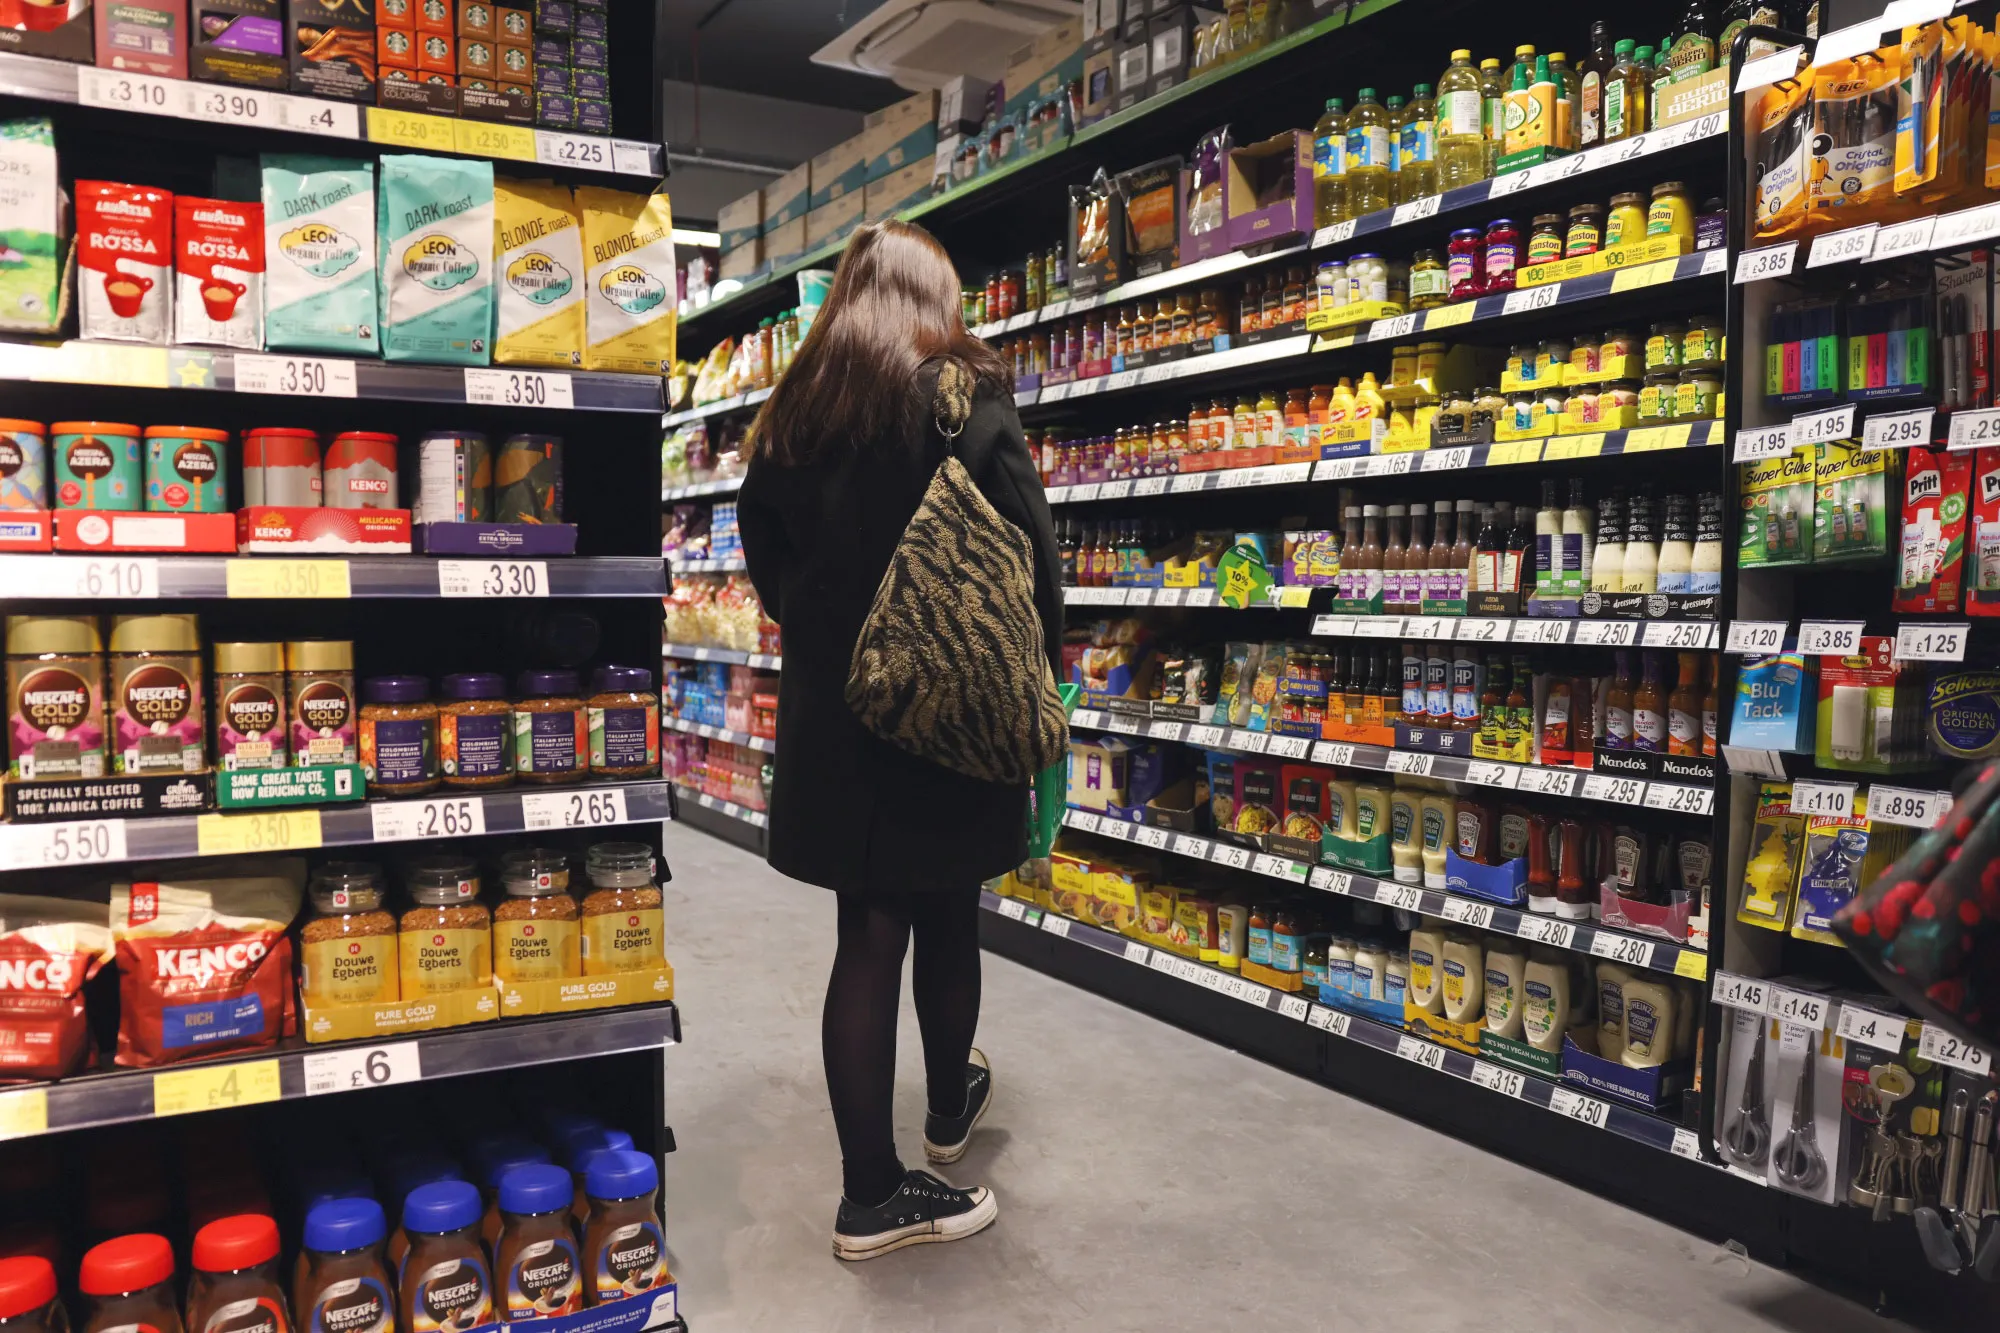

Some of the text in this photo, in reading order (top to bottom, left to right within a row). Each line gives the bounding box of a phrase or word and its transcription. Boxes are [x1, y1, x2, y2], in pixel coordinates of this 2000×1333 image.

[1672, 47, 1705, 63] FILIPPO
[383, 89, 428, 104] COLOMBIA
[1673, 79, 1726, 104] FILIPPO
[463, 94, 510, 108] HOUSE BLEND
[1682, 114, 1720, 143] £4.90
[558, 140, 603, 165] £2.25
[1620, 136, 1646, 160] £2
[1563, 154, 1586, 177] £2
[1835, 155, 1894, 173] Original
[1509, 170, 1531, 192] £2
[96, 199, 153, 218] LAVAZZA
[283, 183, 354, 218] DARK roast
[192, 209, 246, 226] LAVAZZA
[405, 194, 474, 231] DARK roast
[302, 229, 338, 244] LEON
[501, 215, 572, 250] BLONDE roast
[89, 233, 158, 255] ROSSA
[187, 241, 251, 261] ROSSA
[422, 240, 457, 255] LEON
[593, 226, 666, 263] BLONDE roast
[408, 258, 472, 275] Organic Coffee
[525, 259, 553, 273] LEON
[1752, 252, 1788, 275] £3.85
[511, 274, 569, 291] Organic Coffee
[617, 270, 646, 284] LEON
[1937, 264, 1987, 296] Sharpie
[605, 284, 661, 301] Organic Coffee
[505, 374, 546, 405] £3.50
[1808, 415, 1845, 439] £1.95
[1881, 419, 1922, 443] £2.95
[1752, 432, 1787, 453] £1.95
[69, 455, 111, 468] AZERA
[177, 459, 215, 471] AZERA
[1850, 451, 1881, 468] Glue
[1744, 461, 1812, 486] Super Glue
[350, 480, 388, 492] KENCO
[1911, 474, 1938, 495] Pritt
[359, 516, 404, 526] MILLICANO
[254, 527, 293, 539] KENCO
[483, 564, 537, 596] £3.30
[1231, 570, 1249, 587] 10%
[1479, 604, 1505, 612] VINEGAR
[1613, 596, 1643, 609] dressings
[1681, 597, 1714, 610] dressings
[1424, 620, 1441, 638] £1
[1476, 620, 1497, 641] £2
[1532, 622, 1563, 642] £1.40
[1596, 623, 1630, 645] £2.50
[1666, 625, 1701, 647] £2.50
[1744, 629, 1777, 647] £1.20
[1816, 630, 1853, 649] £3.85
[1916, 634, 1957, 654] £1.25
[1404, 667, 1420, 681] HP
[1428, 667, 1445, 682] HP
[1454, 669, 1472, 684] HP
[1751, 683, 1780, 699] Blu
[31, 705, 82, 718] GOLD
[136, 699, 183, 714] GOLD
[308, 709, 345, 721] GOLD
[1743, 702, 1784, 719] Tack
[1942, 709, 1996, 721] ORIGINAL
[37, 717, 75, 725] BLEND
[142, 712, 178, 720] BLEND
[235, 712, 272, 724] GOLD
[1942, 718, 1995, 730] GOLDEN
[1410, 731, 1423, 741] HP
[1440, 735, 1453, 746] HP
[1600, 754, 1648, 770] Nando's
[1662, 760, 1714, 778] Nando's
[231, 773, 291, 787] SAME GREAT
[1484, 765, 1506, 786] £2
[17, 783, 141, 801] SPECIALLY SELECTED
[231, 784, 306, 800] NOW REDUCING
[1604, 780, 1637, 803] £2.95
[16, 797, 144, 815] 100% ARABICA COFFEE
[1667, 788, 1706, 813] £2.95
[1809, 791, 1845, 811] £1.10
[1885, 796, 1926, 820] £8.95
[565, 792, 617, 827] £2.65
[1359, 810, 1374, 818] SALAD
[417, 801, 473, 838] £2.65
[1229, 848, 1244, 866] 75p
[1267, 858, 1287, 879] 75p
[132, 895, 155, 912] 93
[616, 927, 650, 939] Douwe
[1537, 922, 1568, 946] £2.80
[511, 936, 548, 948] Douwe
[614, 936, 652, 951] Egberts
[155, 941, 268, 978] KENCO
[334, 954, 374, 967] Douwe
[420, 946, 459, 959] Douwe
[509, 946, 551, 960] Egberts
[1612, 939, 1647, 965] £2.80
[418, 956, 462, 971] Egberts
[332, 965, 377, 981] Egberts
[560, 981, 617, 995] PURE GOLD
[1729, 983, 1762, 1005] £1.45
[376, 1005, 436, 1020] PURE GOLD
[1527, 1000, 1548, 1009] VEGAN
[1631, 1001, 1653, 1014] HEINZ
[1784, 998, 1820, 1022] £1.45
[185, 1012, 214, 1028] RICH
[1860, 1020, 1876, 1039] £4
[1511, 1045, 1530, 1058] VEGAN
[1531, 1053, 1549, 1065] MAYO
[1940, 1038, 1982, 1066] £2.75
[351, 1050, 391, 1087] £6
[1568, 1070, 1588, 1083] HEINZ
[1606, 1082, 1650, 1102] FREE RANGE EGGS
[1570, 1096, 1602, 1125] £2.50
[616, 1256, 654, 1270] ORIGINAL
[527, 1273, 568, 1289] ORIGINAL
[433, 1293, 476, 1310] ORIGINAL
[601, 1290, 621, 1299] DECAF
[331, 1313, 377, 1330] ORIGINAL
[512, 1309, 534, 1318] DECAF
[628, 1308, 646, 1318] TASTE
